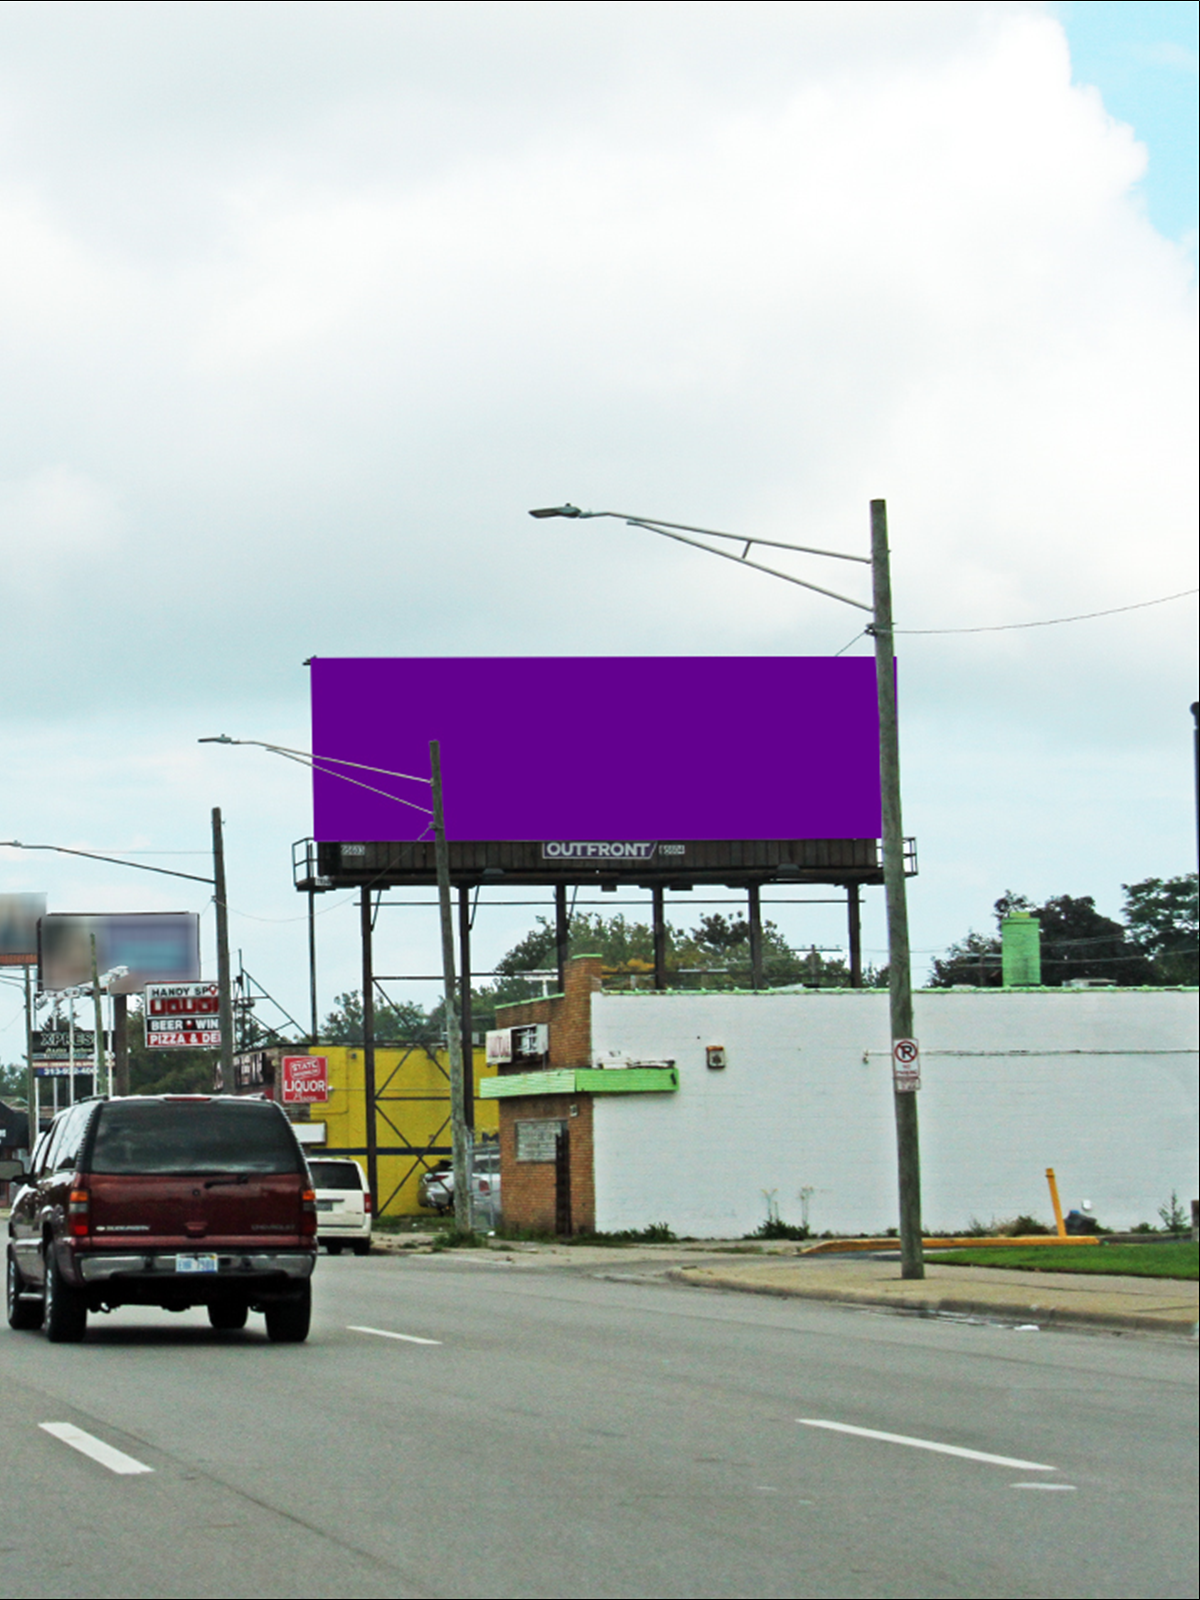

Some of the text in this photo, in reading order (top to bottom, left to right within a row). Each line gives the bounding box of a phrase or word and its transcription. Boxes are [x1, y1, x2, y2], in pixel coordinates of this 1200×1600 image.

[546, 842, 651, 856] OUTFRONT
[151, 1018, 219, 1031] BEER WIN
[150, 1033, 186, 1045] PIZZA
[202, 1033, 221, 1043] DE
[284, 1080, 325, 1093] LIQUOR
